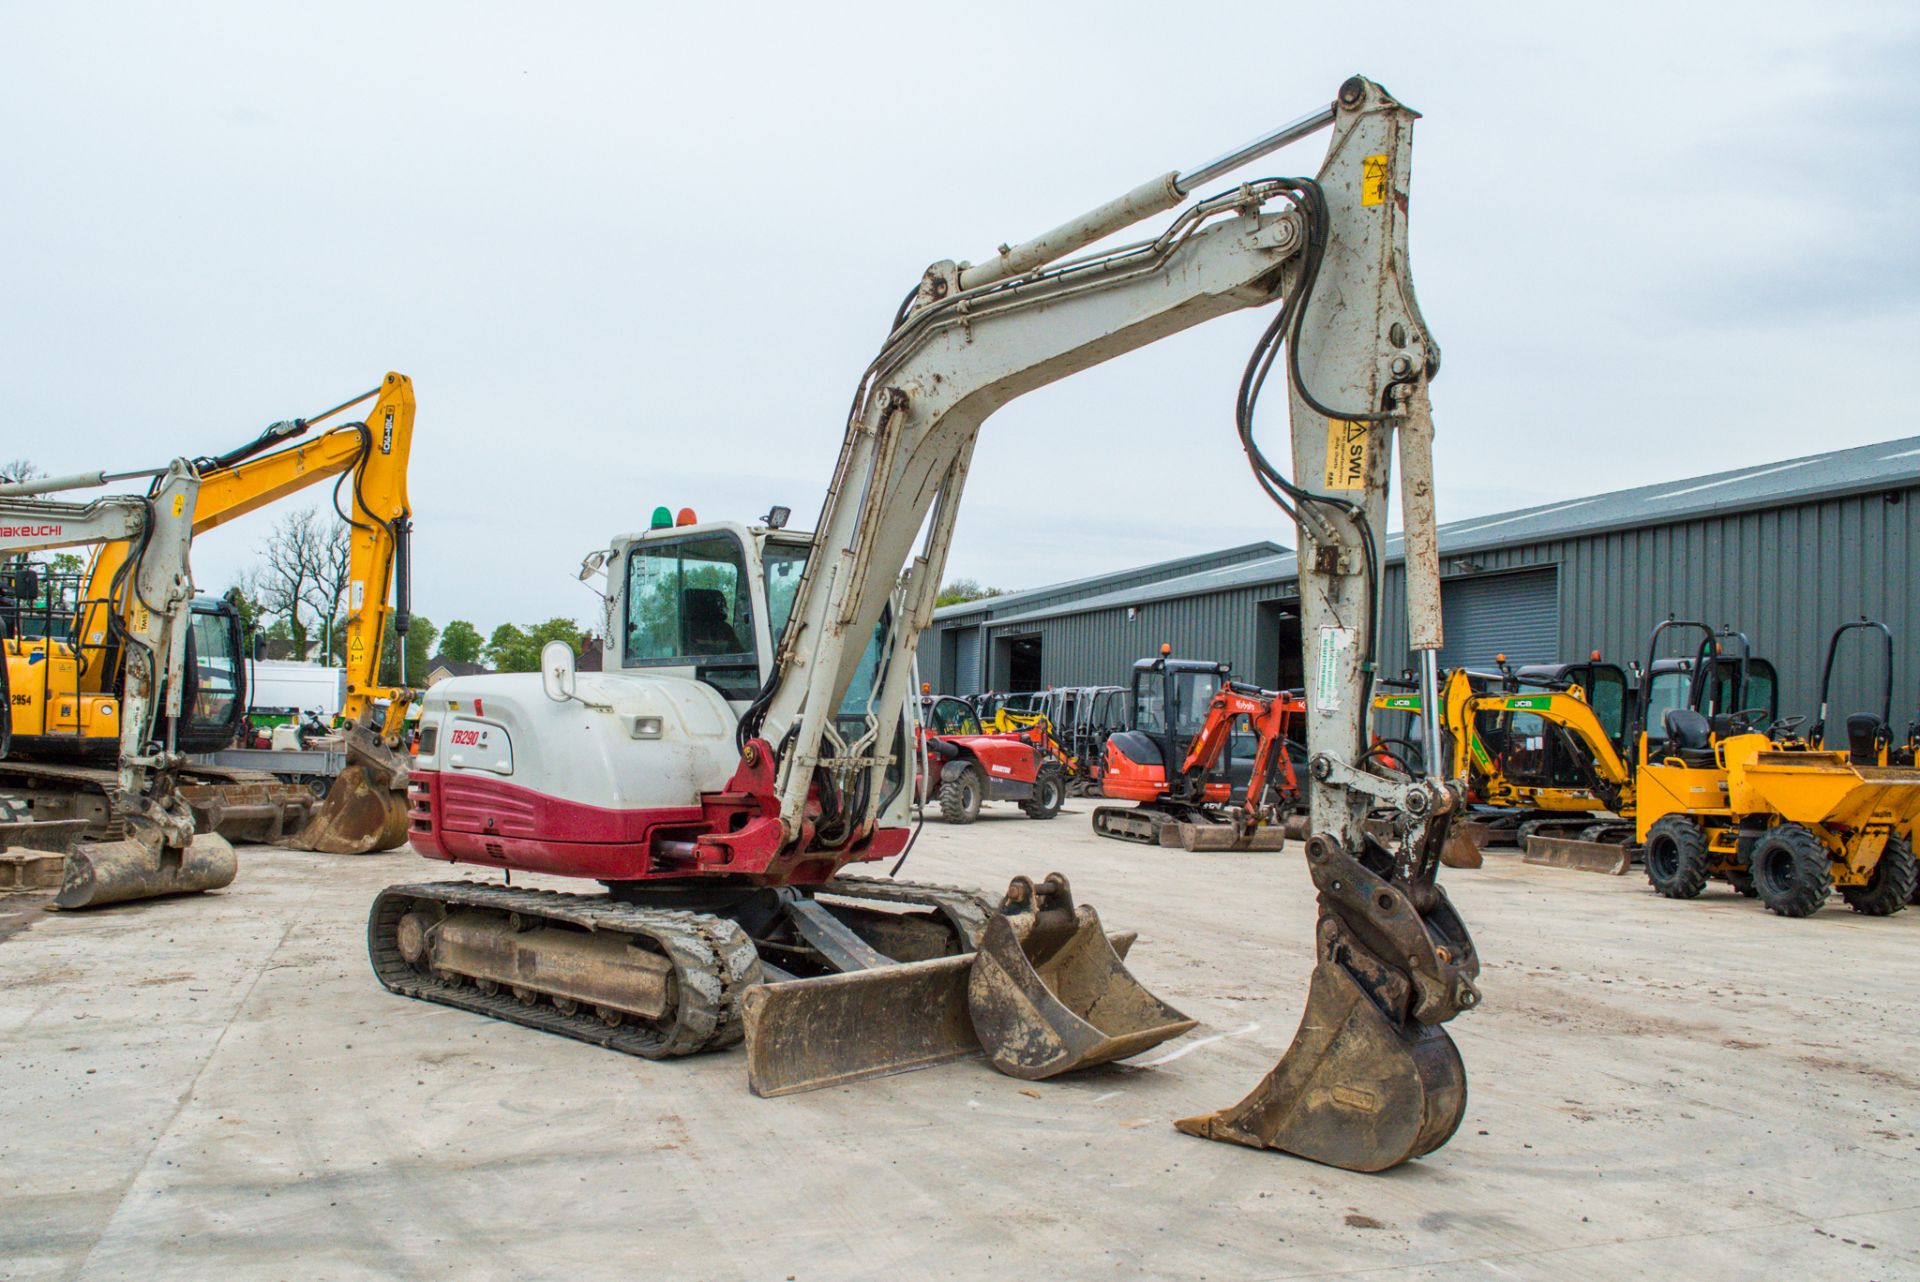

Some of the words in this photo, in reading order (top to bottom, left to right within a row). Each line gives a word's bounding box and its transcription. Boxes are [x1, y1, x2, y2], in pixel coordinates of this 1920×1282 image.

[1348, 445, 1363, 485] SWL
[11, 694, 32, 706] 2954
[451, 729, 480, 746] TB290
